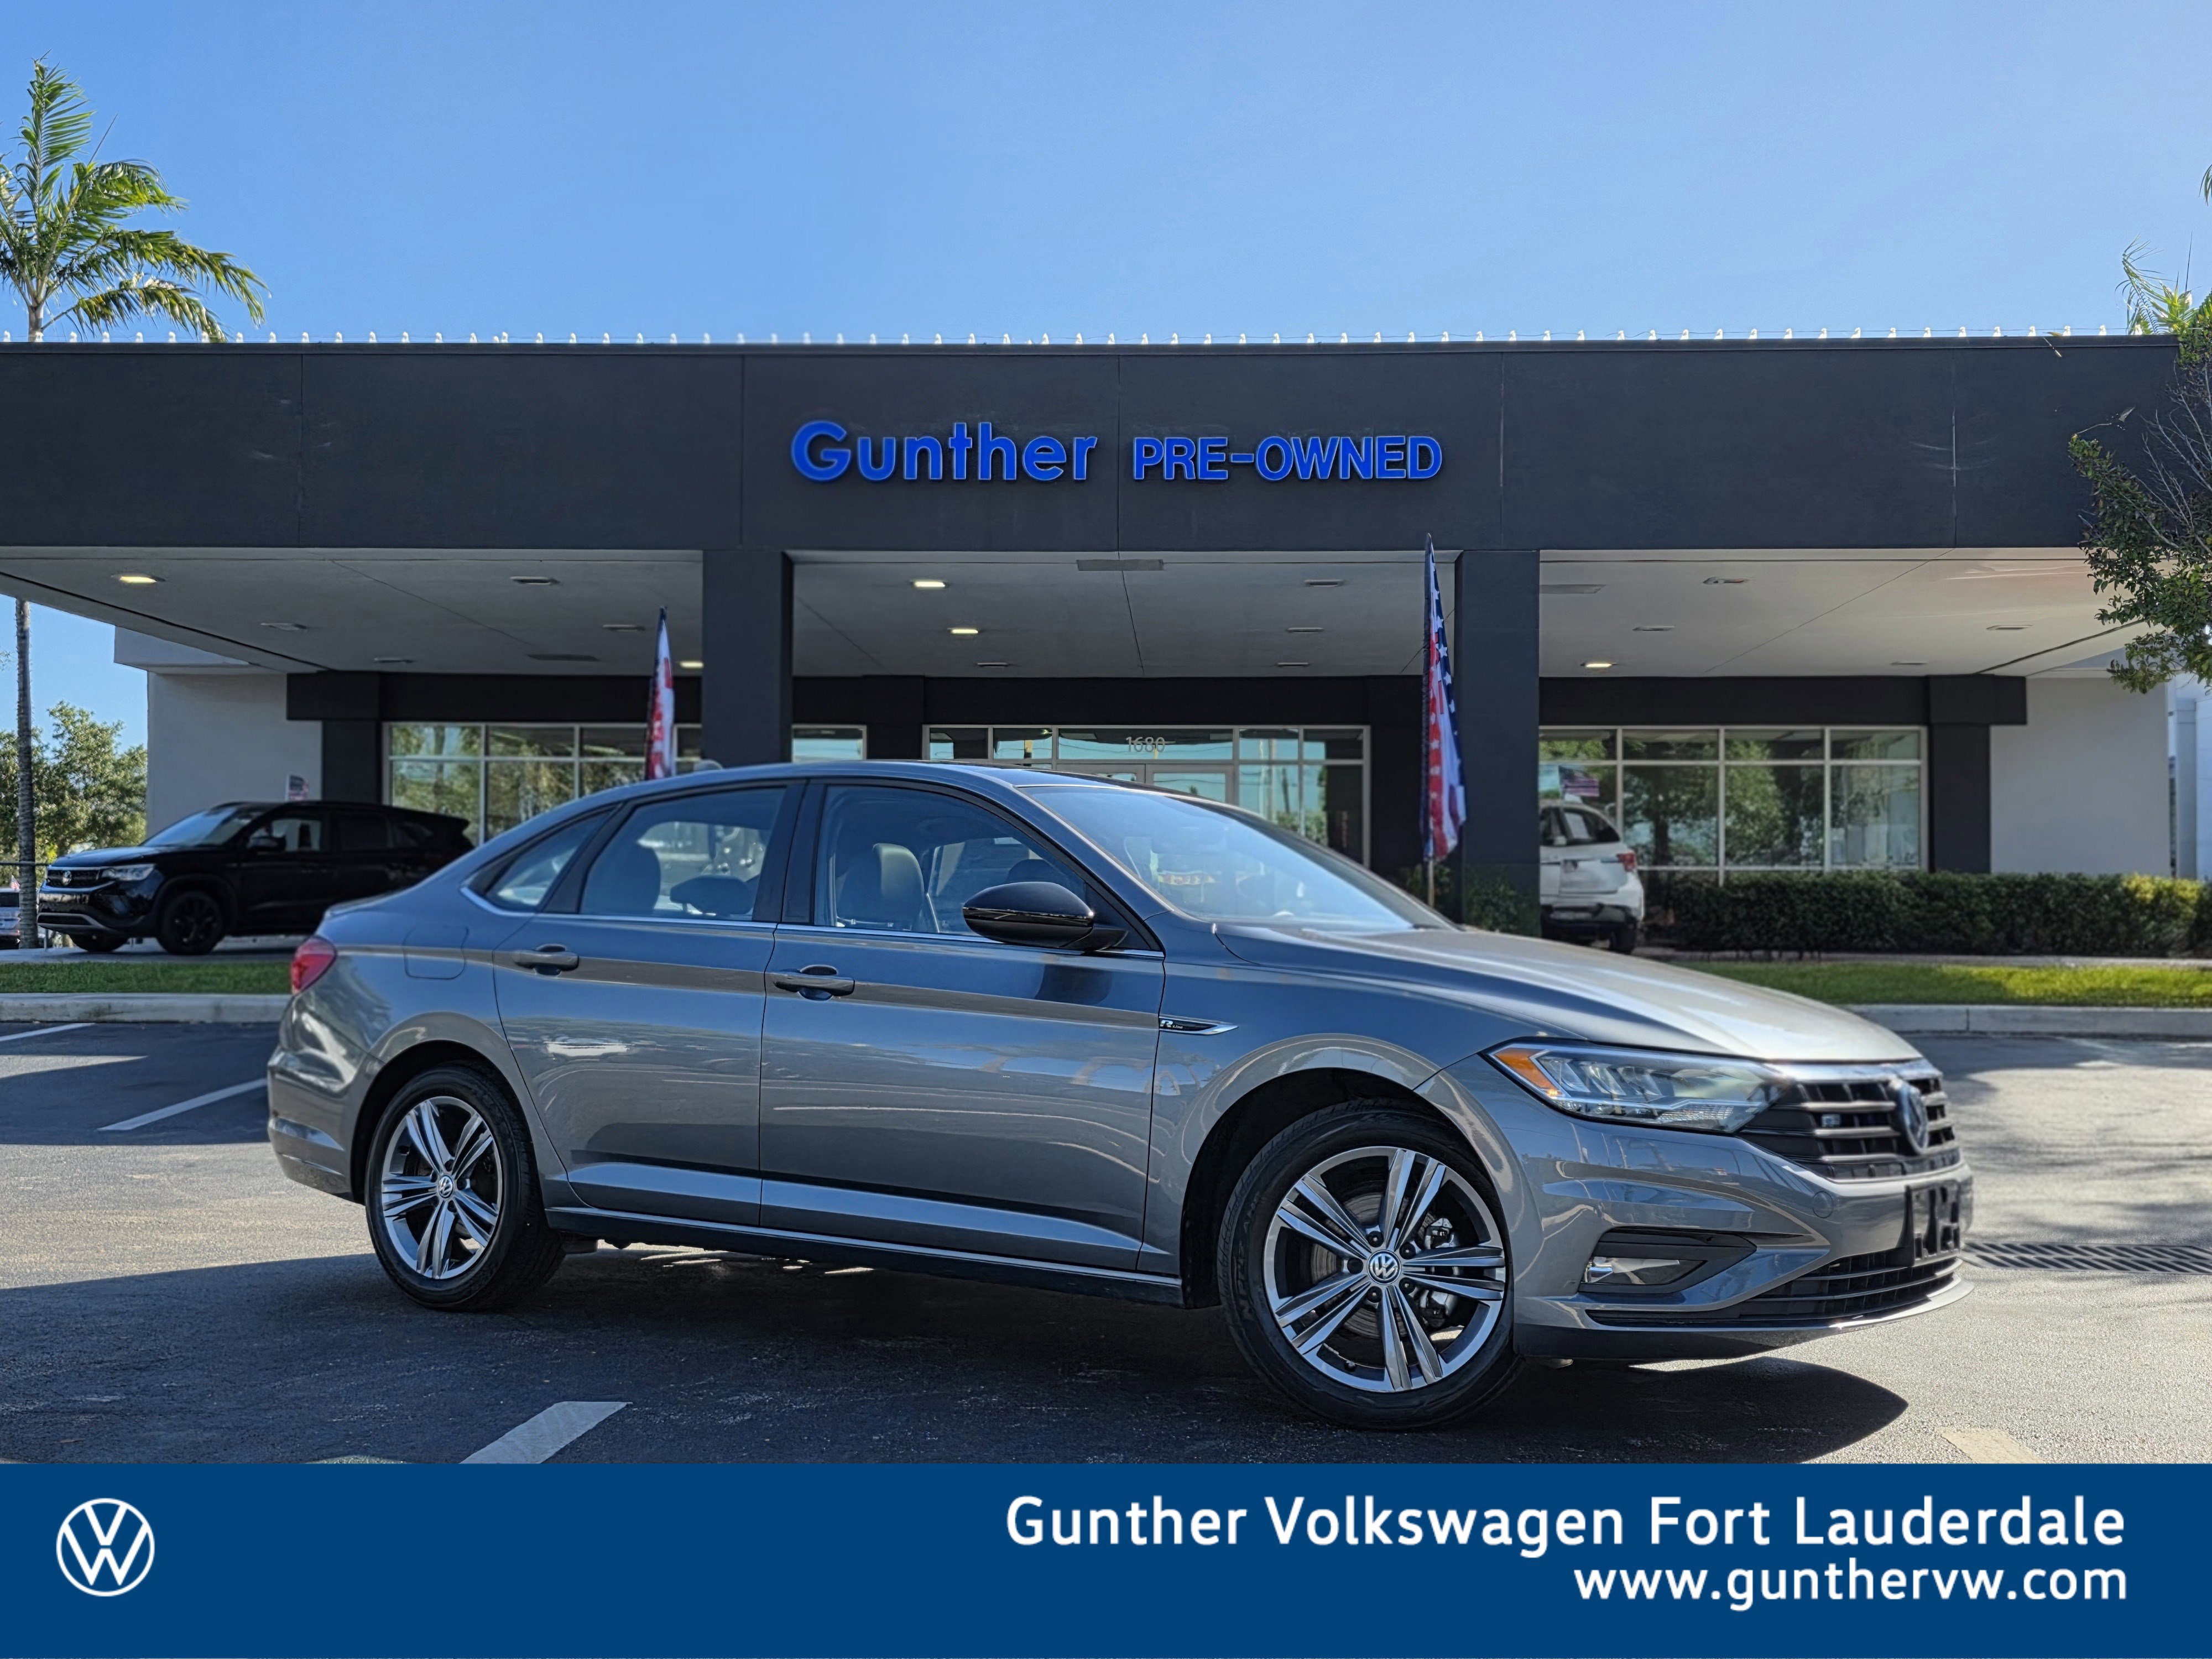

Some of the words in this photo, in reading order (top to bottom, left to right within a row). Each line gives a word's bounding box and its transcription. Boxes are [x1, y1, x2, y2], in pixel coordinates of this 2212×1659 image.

[791, 420, 1098, 482] Gunther
[1133, 435, 1442, 481] PRE-OWNED
[1126, 737, 1165, 753] 1680
